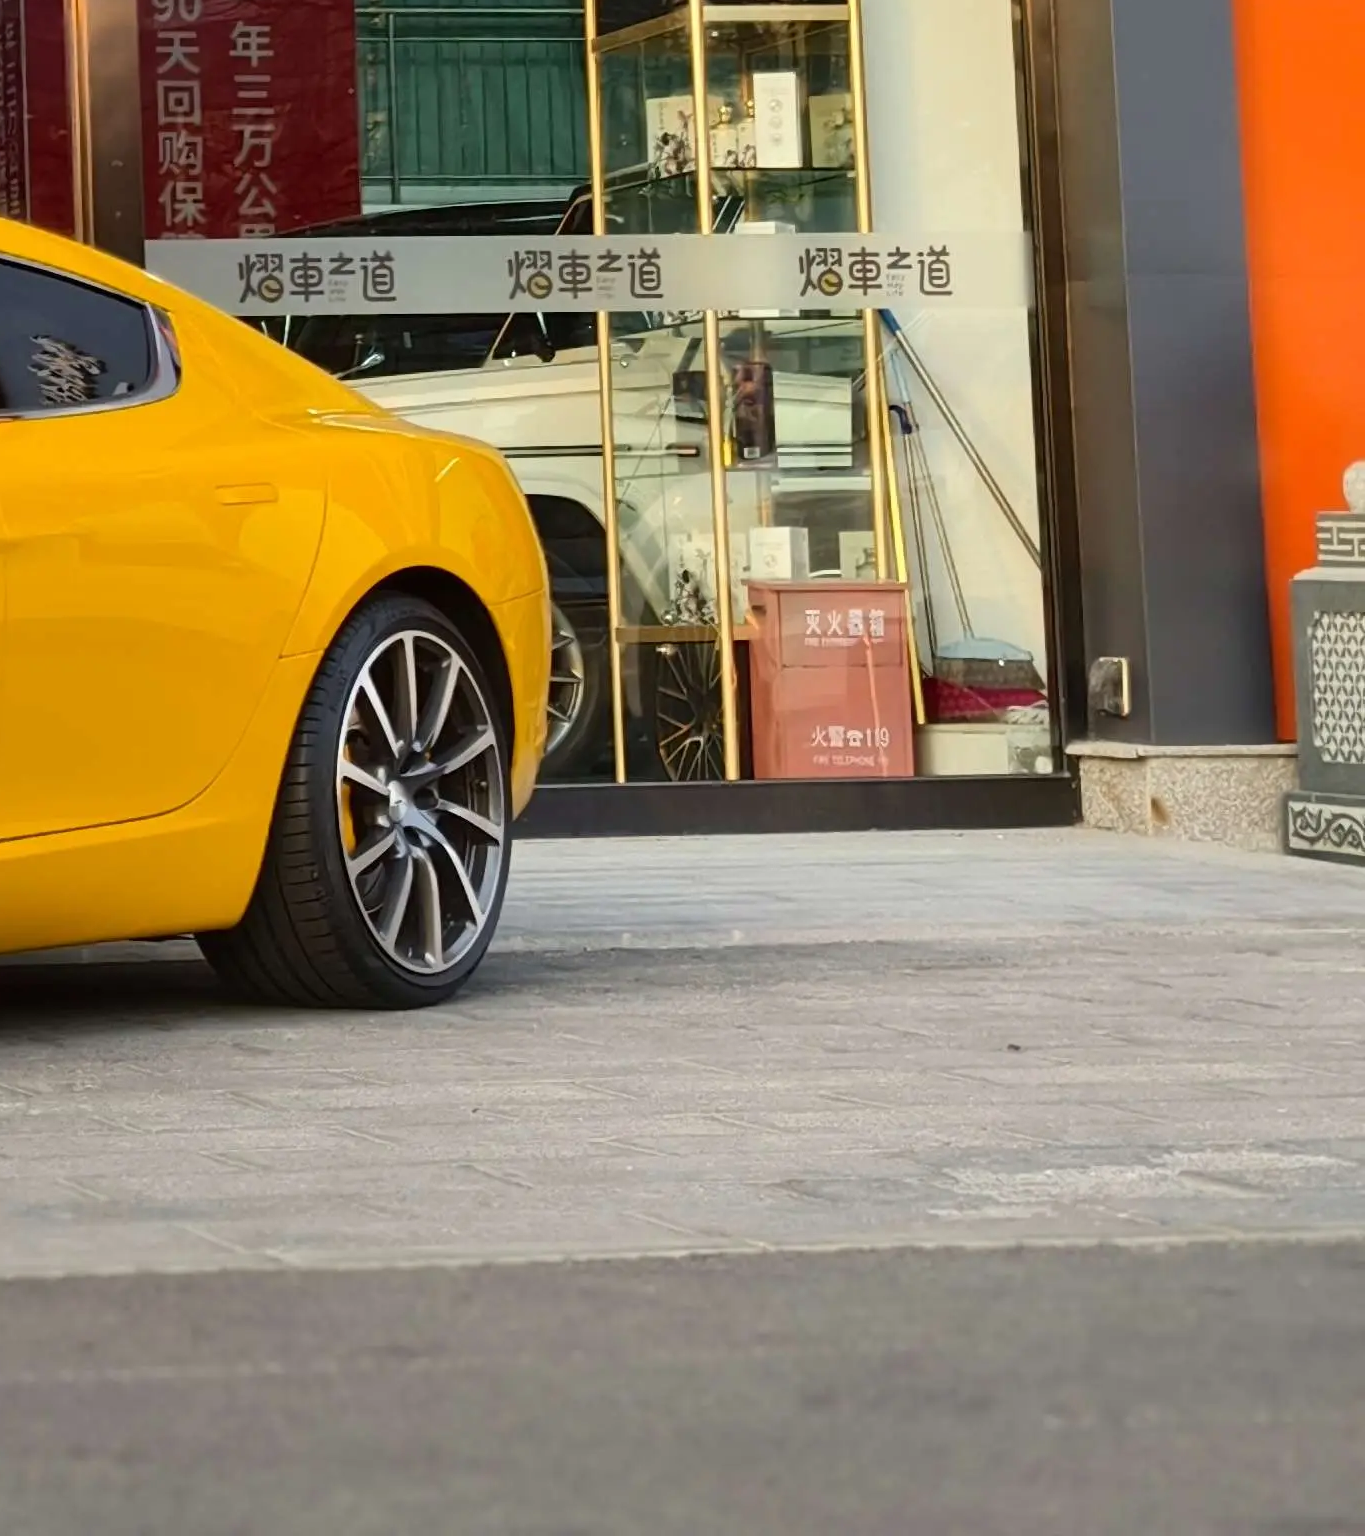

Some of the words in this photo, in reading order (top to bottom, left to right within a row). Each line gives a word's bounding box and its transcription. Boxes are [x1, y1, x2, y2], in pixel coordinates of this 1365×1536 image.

[237, 250, 397, 303] 熠車之道
[507, 247, 664, 300] 熠車之道
[799, 245, 953, 297] 熠車之道
